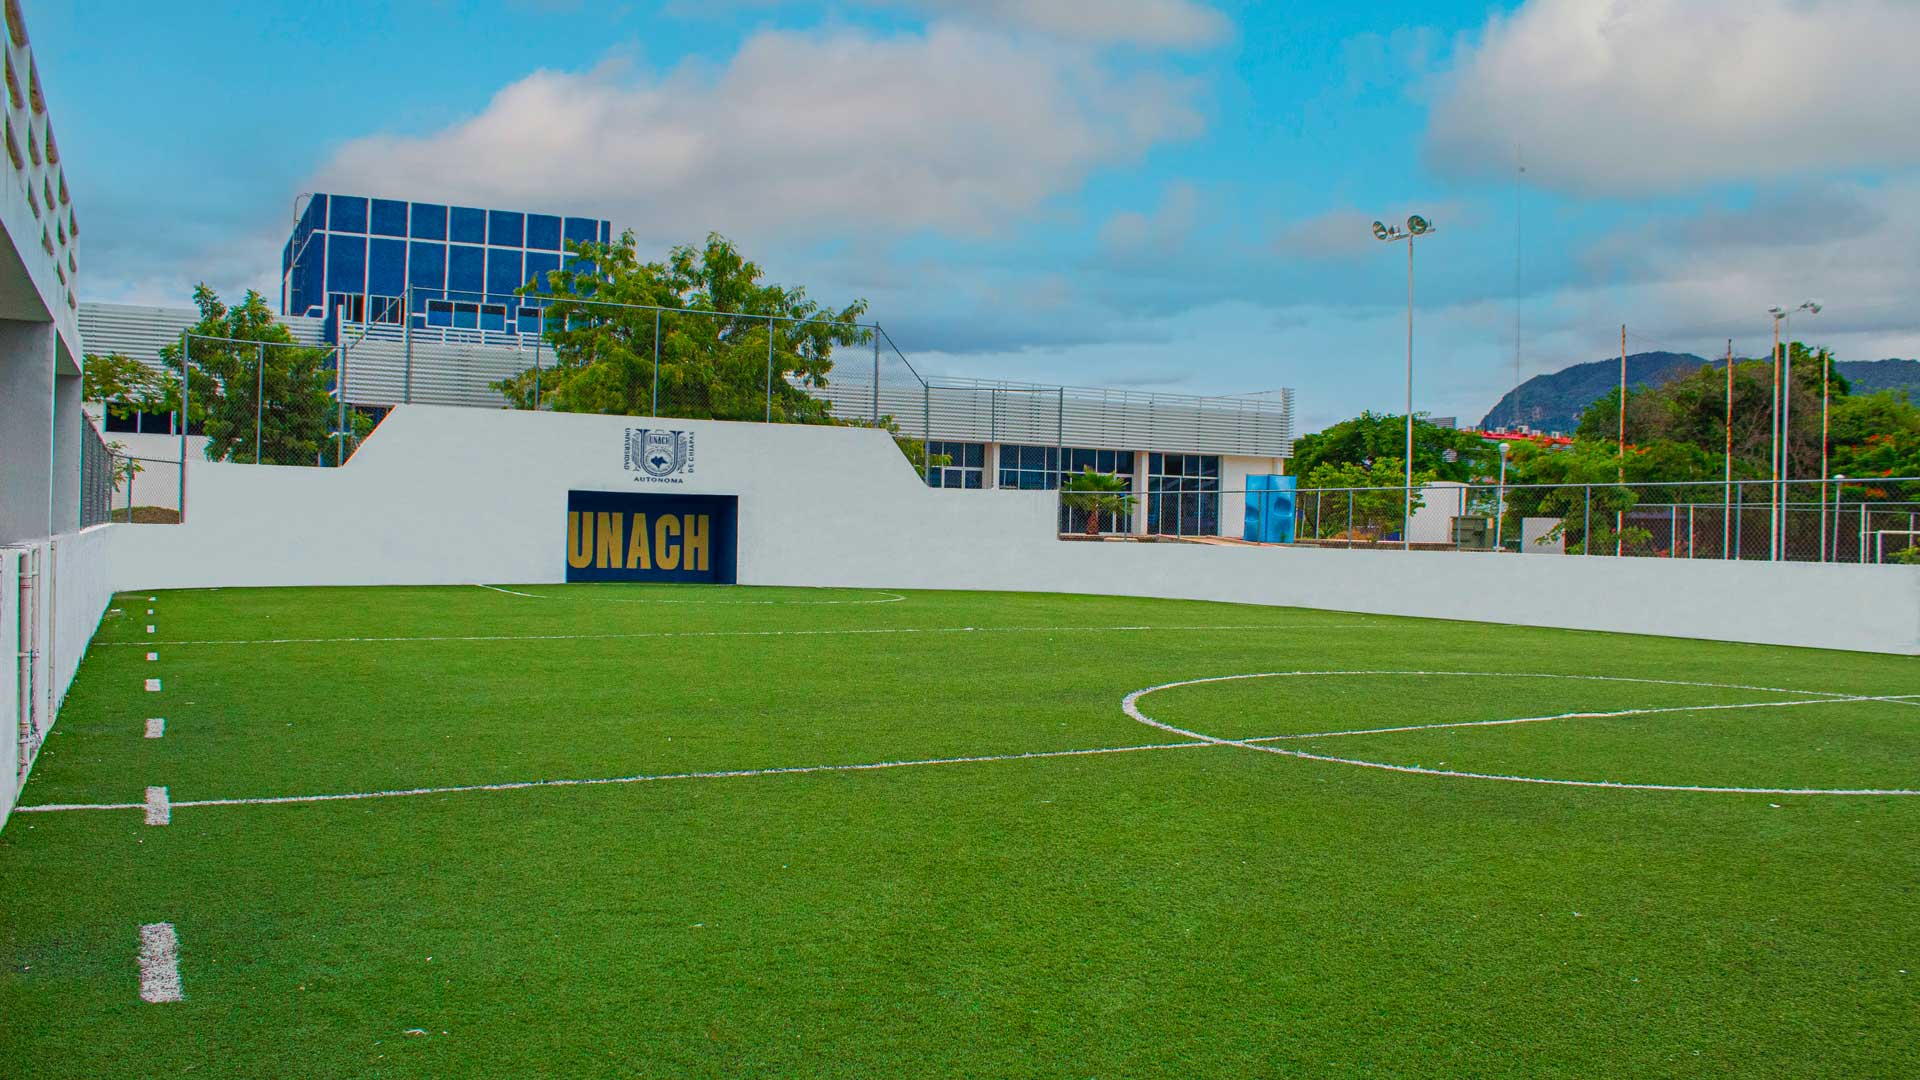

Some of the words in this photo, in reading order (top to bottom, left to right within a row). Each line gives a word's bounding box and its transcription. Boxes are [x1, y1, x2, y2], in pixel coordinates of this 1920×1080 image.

[688, 464, 695, 473] DE
[633, 476, 684, 484] AUTONOMA
[567, 511, 709, 571] UNACH
